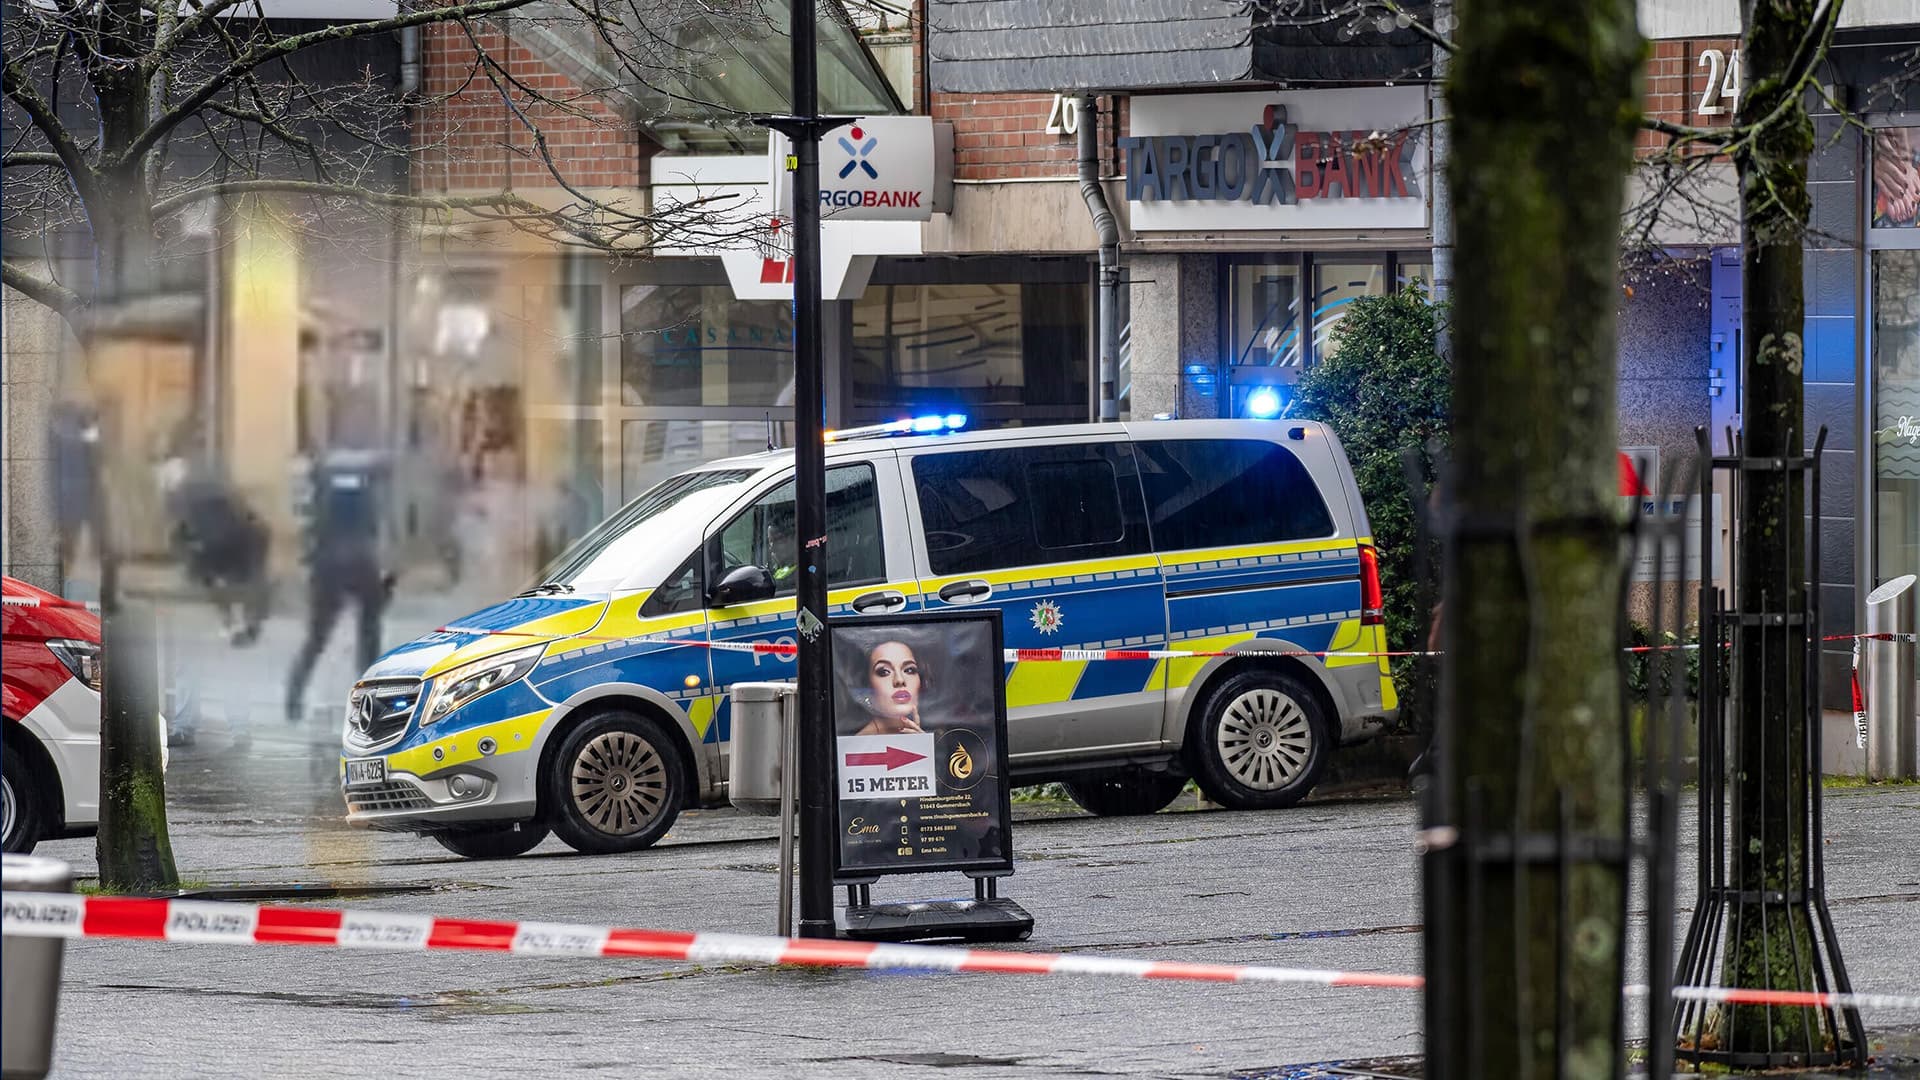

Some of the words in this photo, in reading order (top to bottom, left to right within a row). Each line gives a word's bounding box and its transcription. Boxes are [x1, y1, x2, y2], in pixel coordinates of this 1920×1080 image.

[1698, 48, 1741, 115] 24
[1117, 132, 1247, 201] TARGO
[1295, 130, 1410, 200] BANK
[819, 190, 922, 208] RGOBANK
[752, 635, 798, 667] PO
[847, 778, 865, 793] 15
[869, 775, 930, 792] METER
[847, 816, 881, 836] Ema
